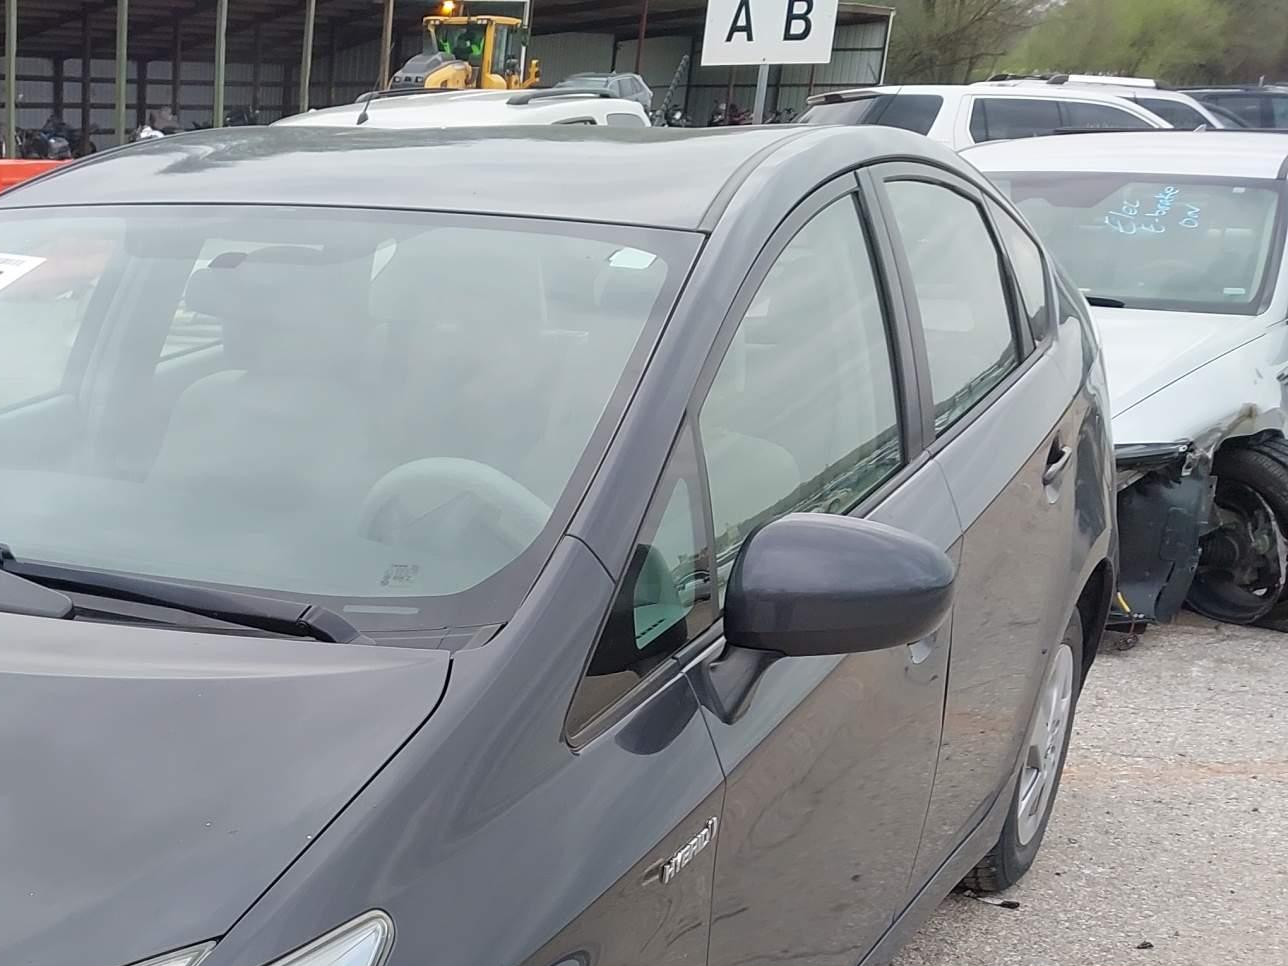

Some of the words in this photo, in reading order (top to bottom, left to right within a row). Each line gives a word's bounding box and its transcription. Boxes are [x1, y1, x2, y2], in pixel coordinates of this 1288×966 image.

[725, 0, 754, 41] A
[783, 0, 814, 40] B
[663, 816, 718, 884] HYBRID
